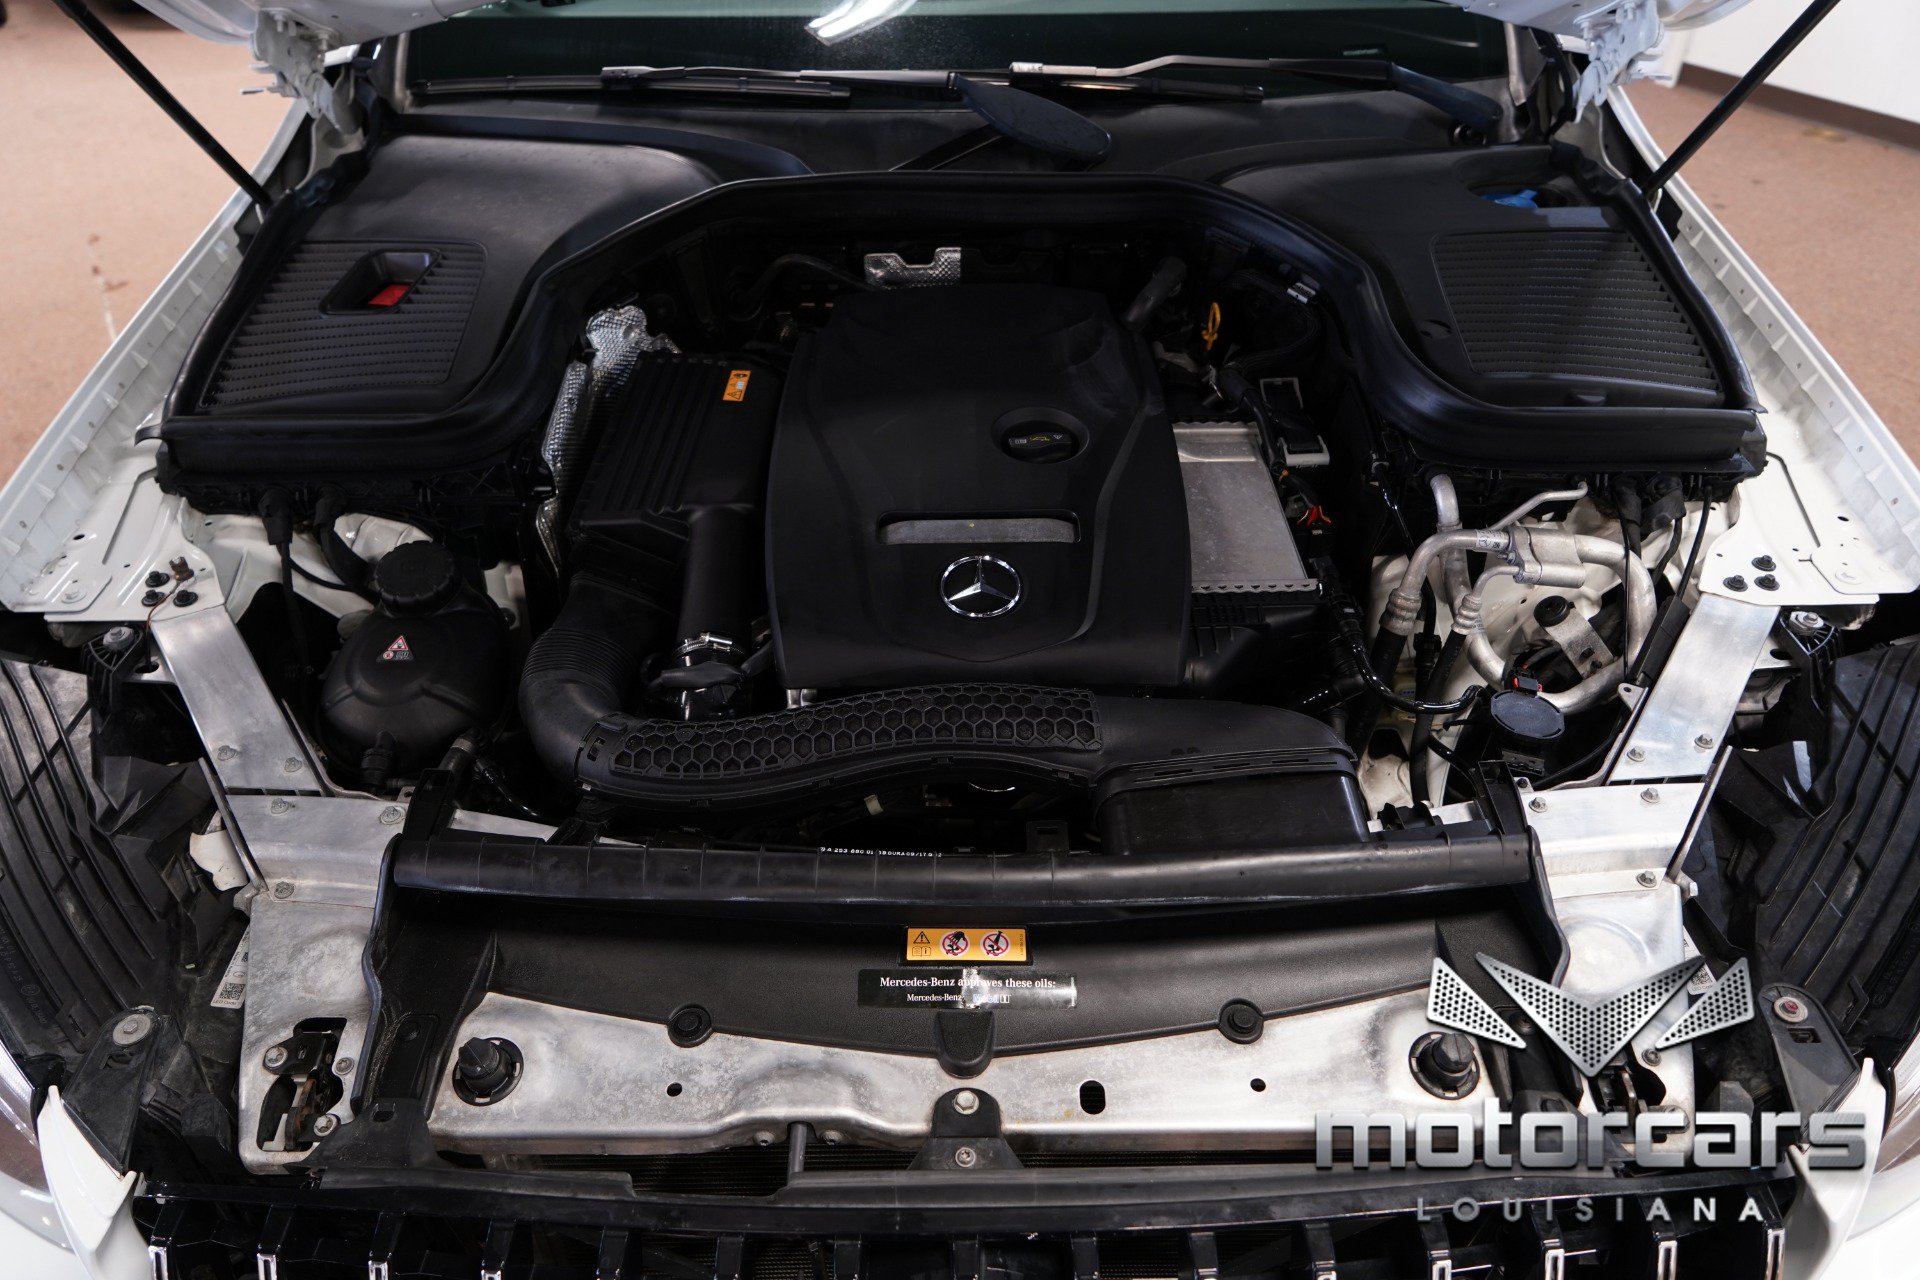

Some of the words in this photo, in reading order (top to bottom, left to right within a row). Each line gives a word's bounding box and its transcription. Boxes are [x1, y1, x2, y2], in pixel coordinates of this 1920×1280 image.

[880, 977, 955, 987] Mercedes-Benz
[957, 978, 1003, 989] approves
[1005, 978, 1033, 988] these
[1035, 978, 1056, 988] oils:
[907, 993, 962, 1002] Mercedes-Benz
